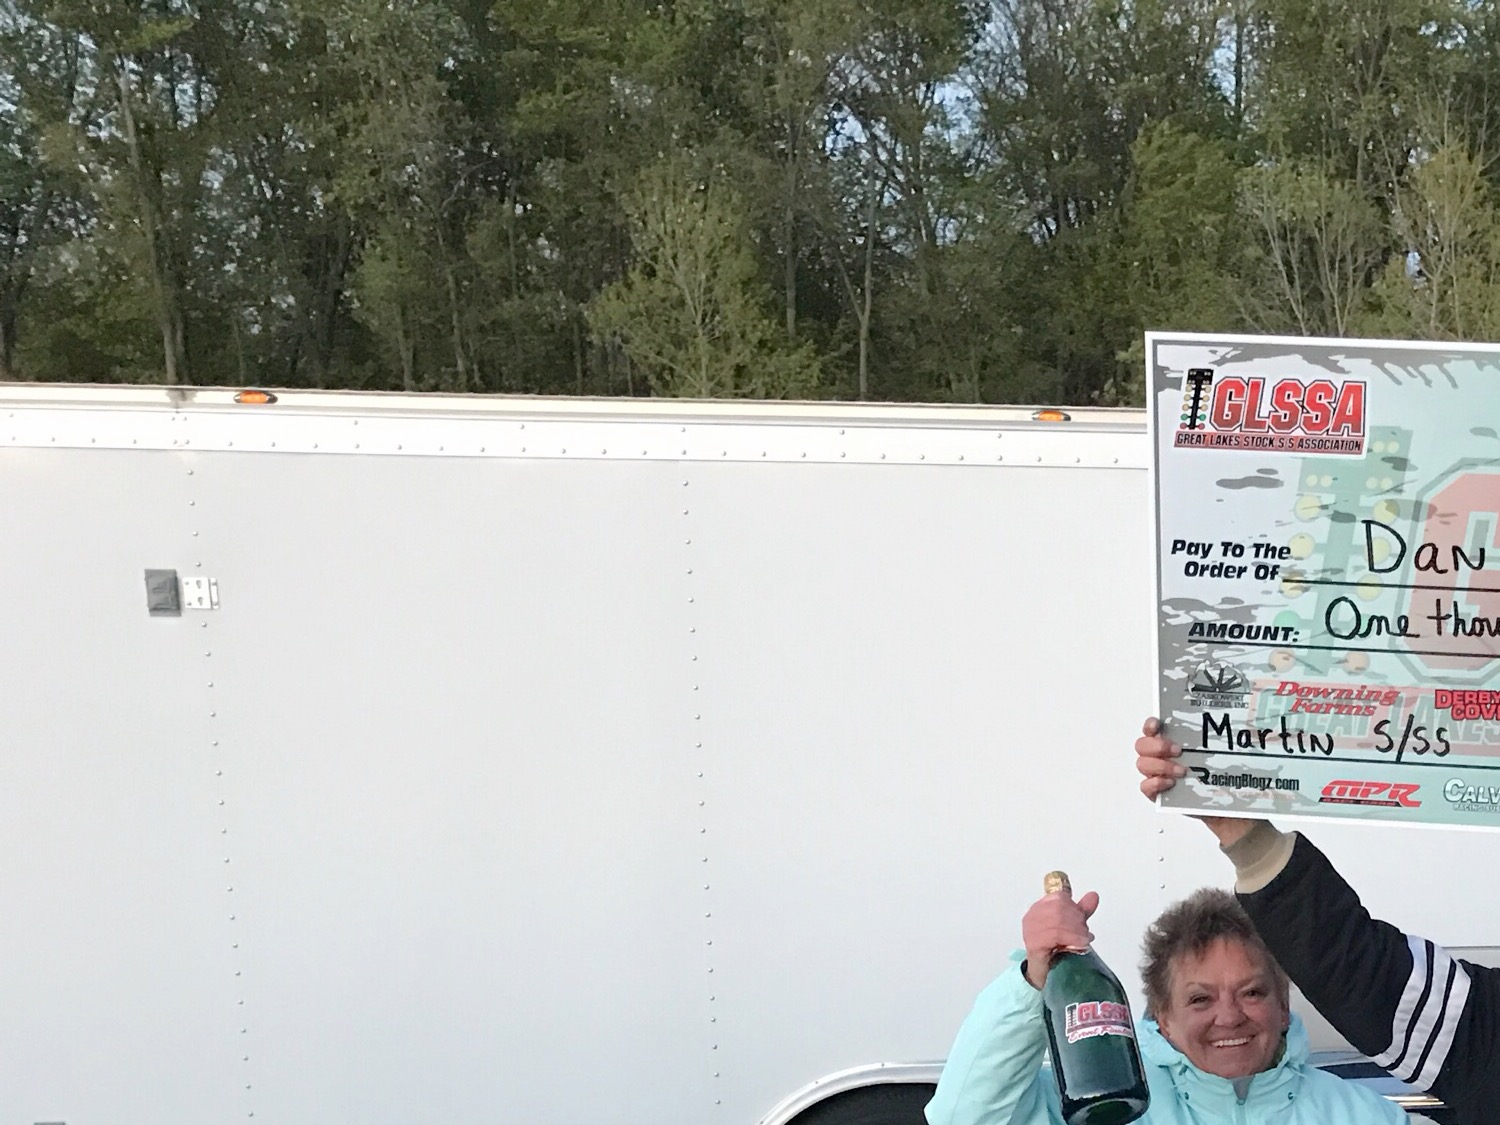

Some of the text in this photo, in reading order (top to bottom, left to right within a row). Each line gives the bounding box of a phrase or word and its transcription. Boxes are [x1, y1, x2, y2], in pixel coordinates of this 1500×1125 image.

[1210, 376, 1367, 437] GLSSA
[1177, 432, 1207, 445] GREAT
[1210, 434, 1240, 447] LAKES
[1243, 436, 1275, 448] STOCK
[1297, 438, 1362, 451] ASSOCIATION
[1171, 539, 1291, 560] Pay To The
[1361, 520, 1486, 574] Dan
[1184, 561, 1281, 581] Order Of
[1324, 596, 1420, 640] One
[1188, 622, 1300, 644] AMOUNT:
[1273, 681, 1400, 705] Downing
[1288, 698, 1378, 717] Farms
[1201, 712, 1335, 756] Martin
[1320, 778, 1422, 808] MPR
